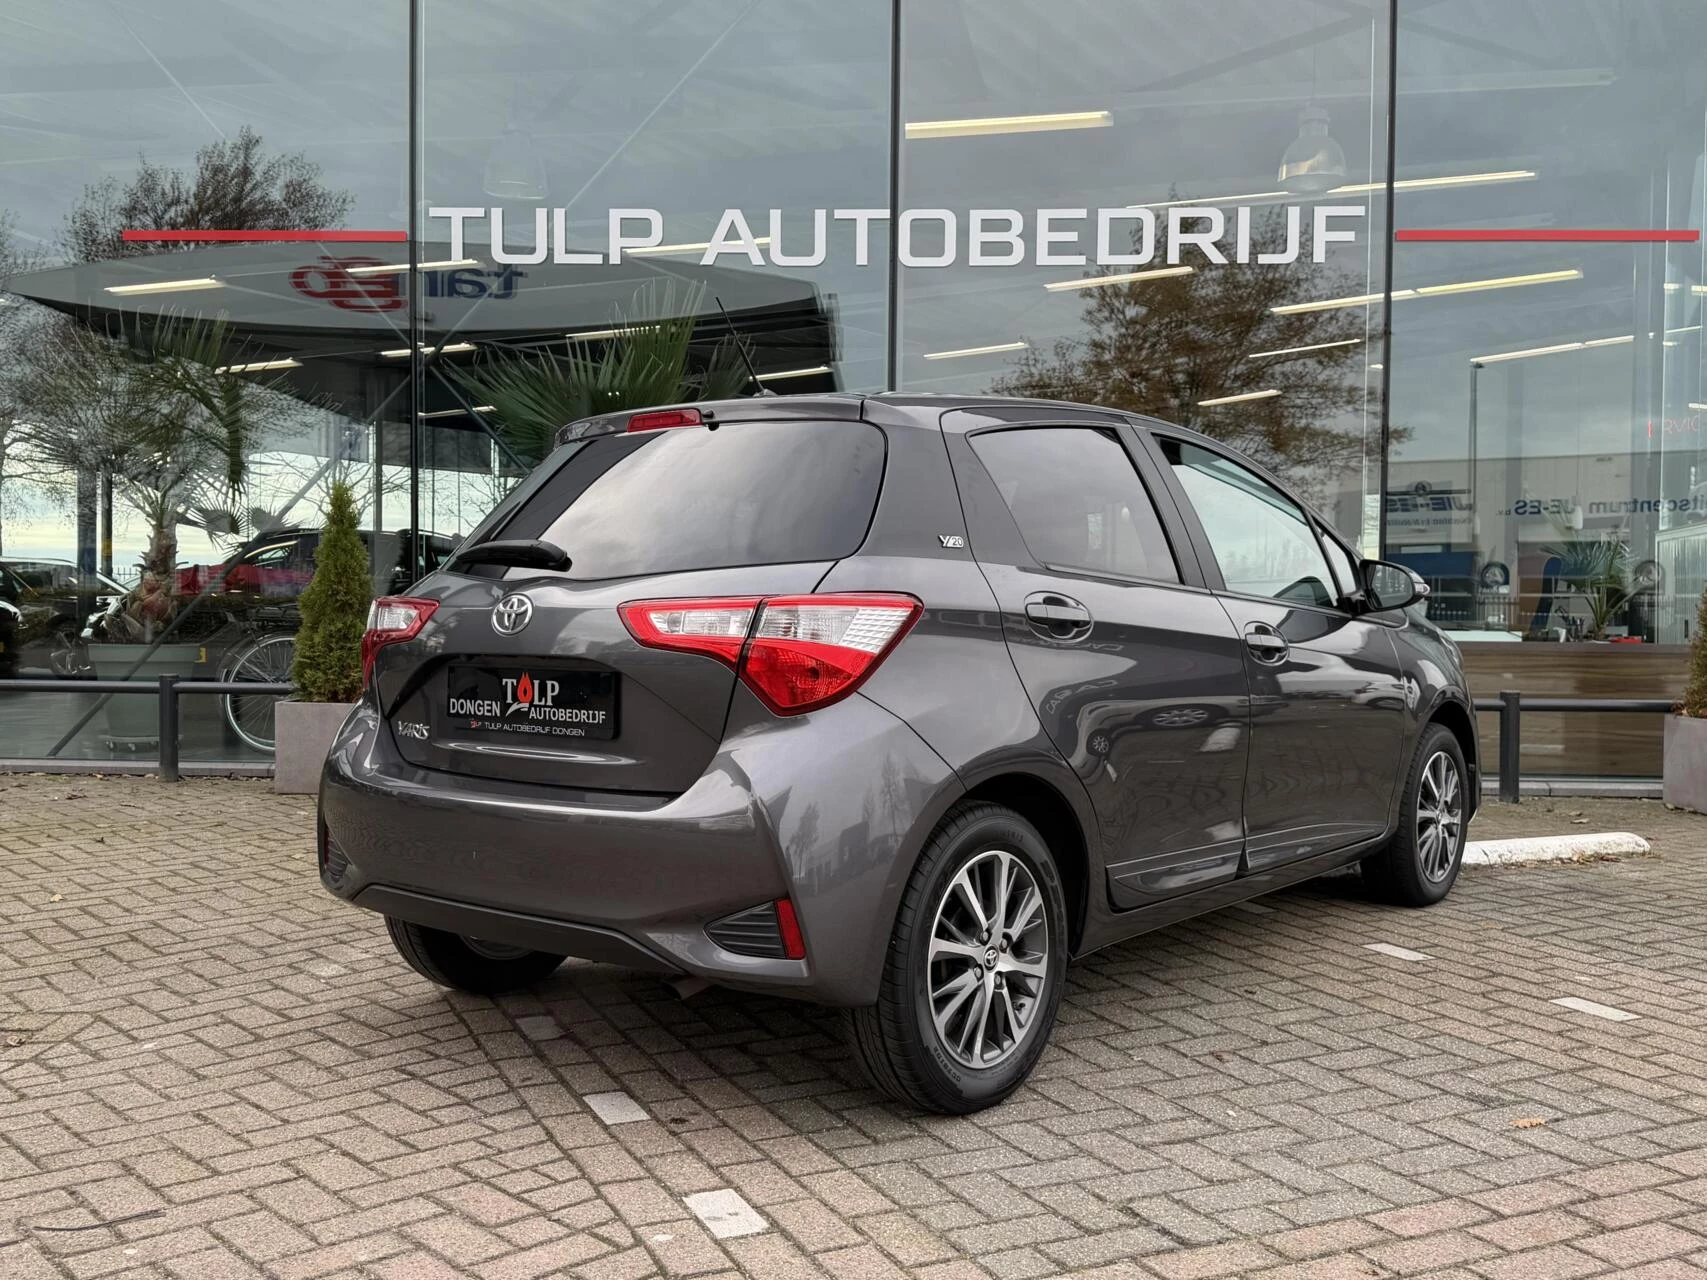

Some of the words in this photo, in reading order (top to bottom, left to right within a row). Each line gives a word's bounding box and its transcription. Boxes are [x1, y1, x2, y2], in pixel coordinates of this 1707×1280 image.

[428, 207, 664, 265] TULP
[700, 205, 1366, 268] AUTOBEDRIJF
[449, 698, 500, 717] DONGEN
[529, 707, 607, 724] AUTOBEDRIJF
[484, 721, 501, 730] TULP
[503, 723, 551, 734] AUTOBEDRIJF
[552, 727, 585, 737] DONGEN
